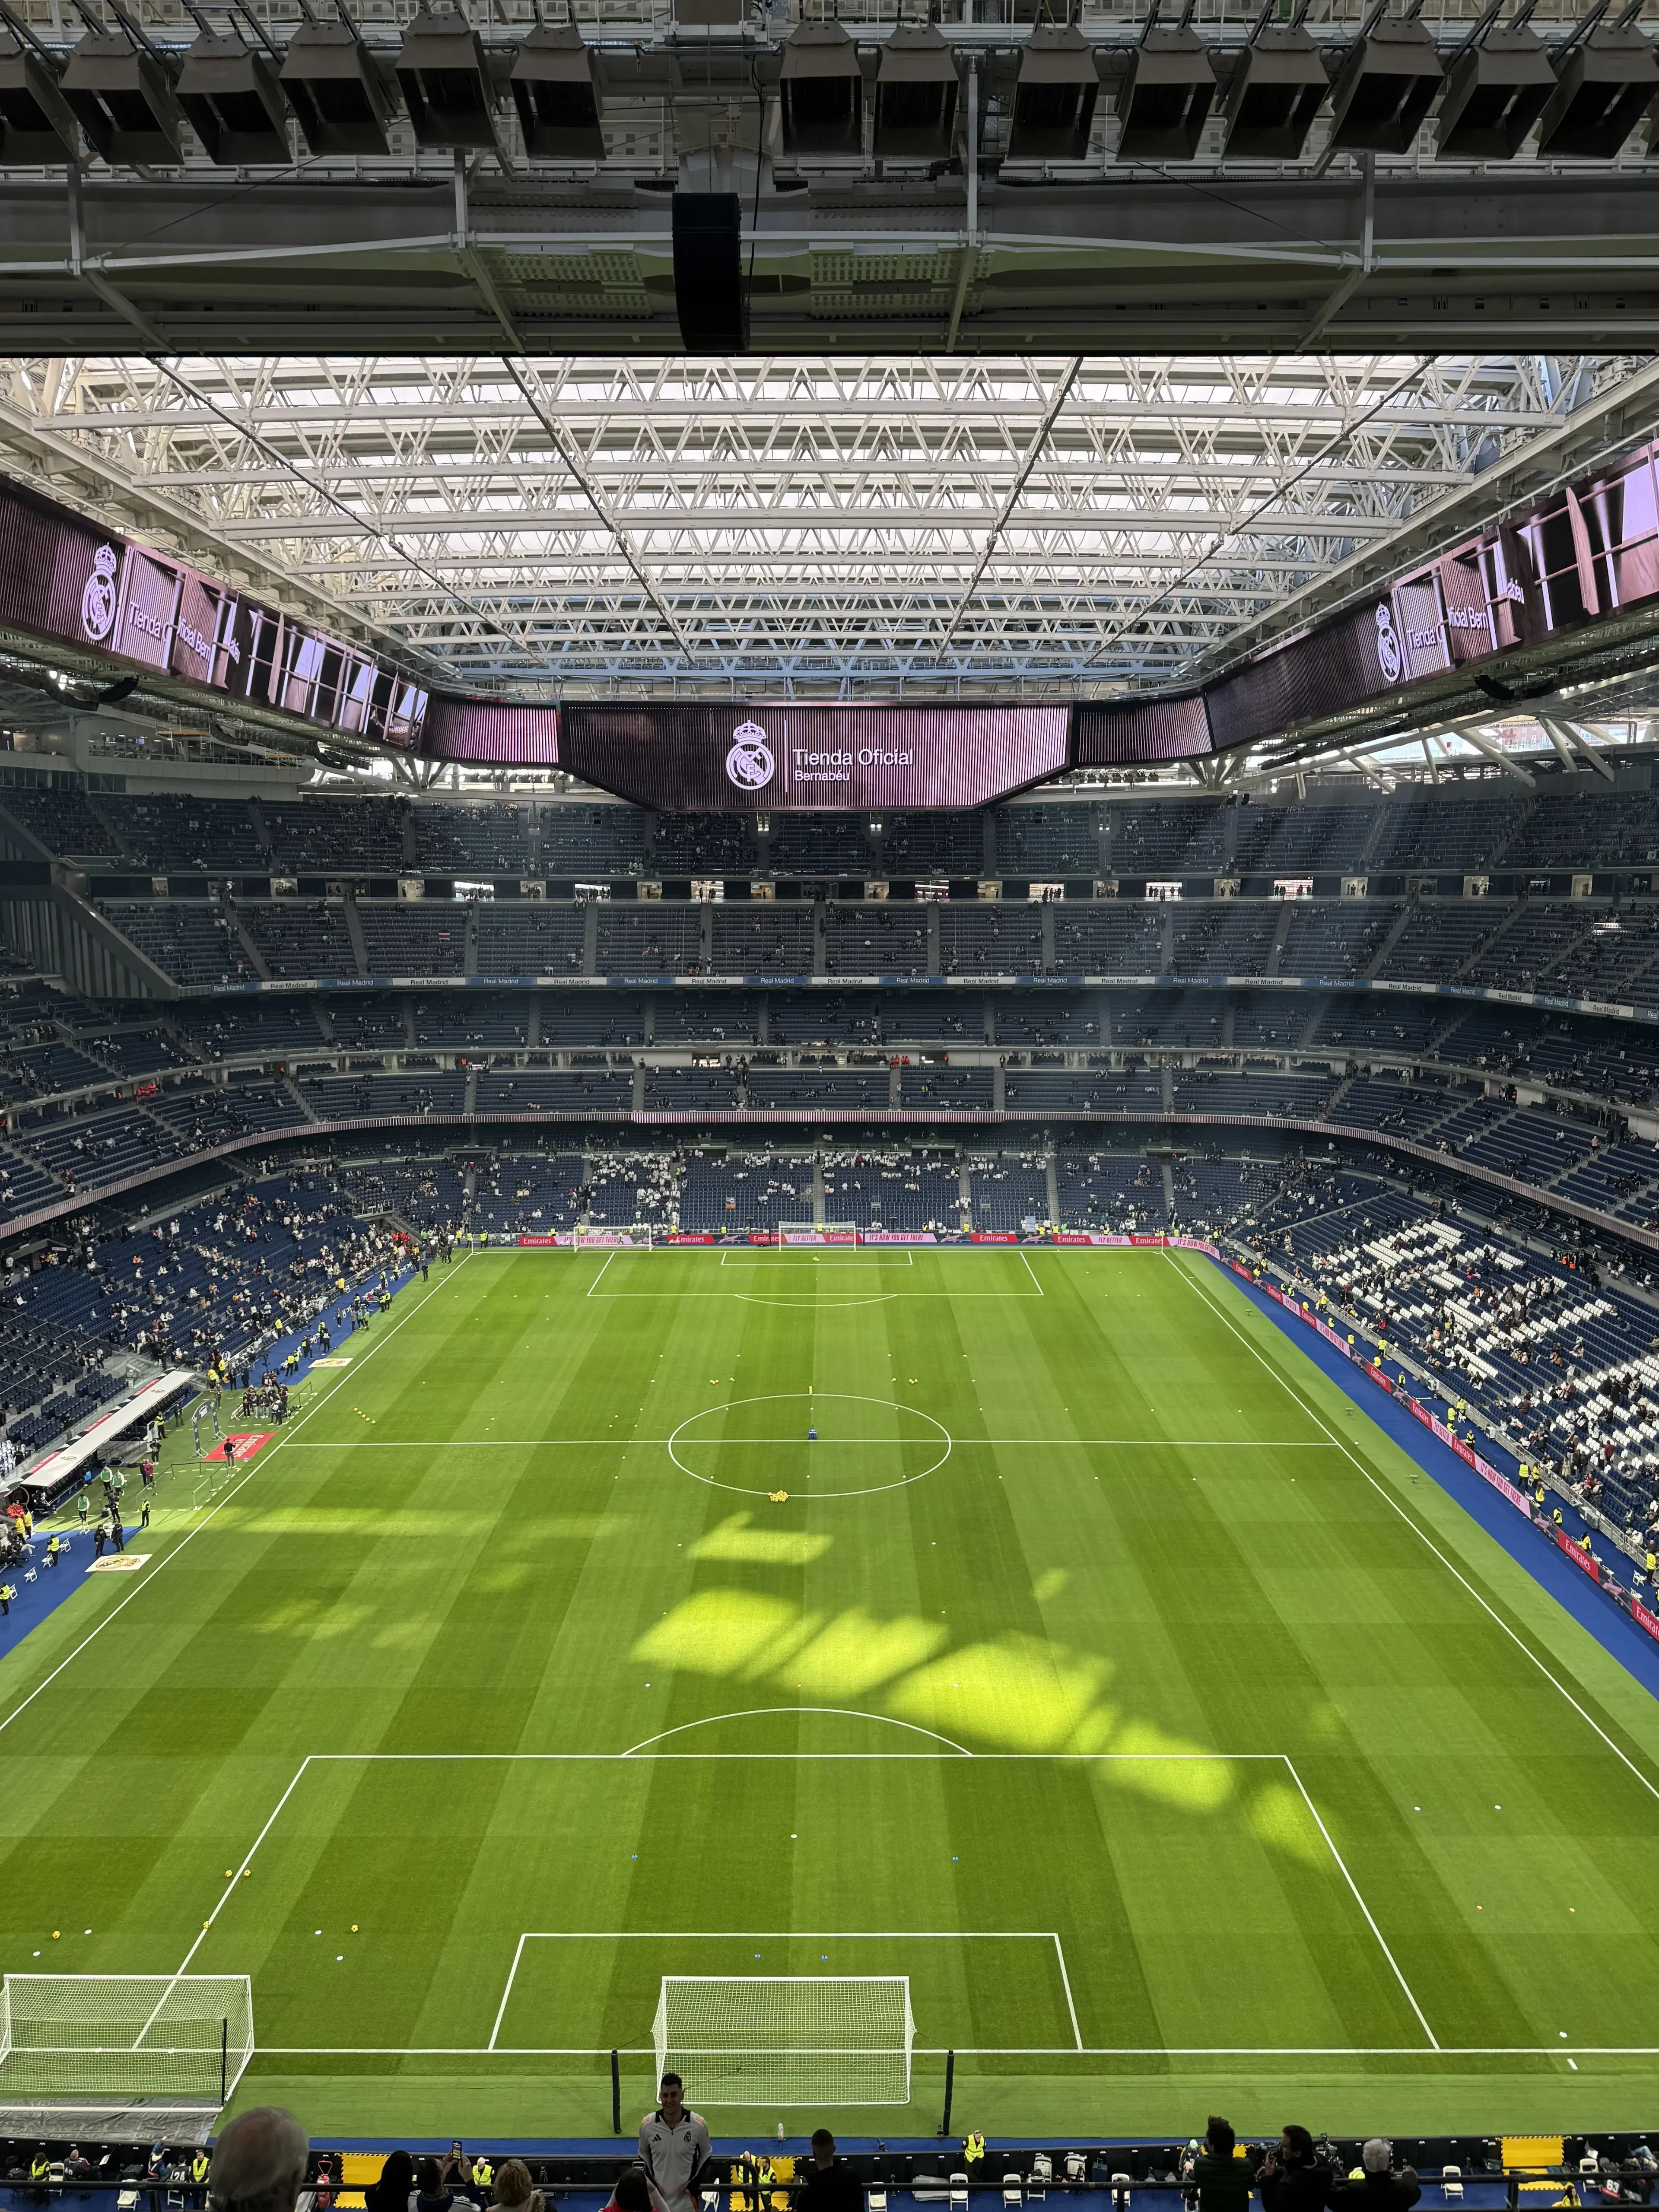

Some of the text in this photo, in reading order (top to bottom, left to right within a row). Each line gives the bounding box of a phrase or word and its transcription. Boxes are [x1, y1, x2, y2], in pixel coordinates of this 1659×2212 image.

[129, 601, 160, 638] Tienda
[1407, 627, 1437, 648] Tienda
[792, 749, 912, 765] Tienda Oficial
[795, 769, 850, 781] Bernabéu
[1647, 1011, 1658, 1019] Real
[1236, 1264, 1248, 1277] Emirates
[1268, 1286, 1281, 1301] Emirates
[1302, 1309, 1315, 1325] Emirates
[1371, 1367, 1386, 1386] Emirates
[1413, 1402, 1429, 1424] Emirates
[1454, 1439, 1472, 1462] Emirates
[1487, 1468, 1496, 1483] HOW
[1510, 1488, 1521, 1506] THERE
[1566, 1539, 1590, 1570] Emirates
